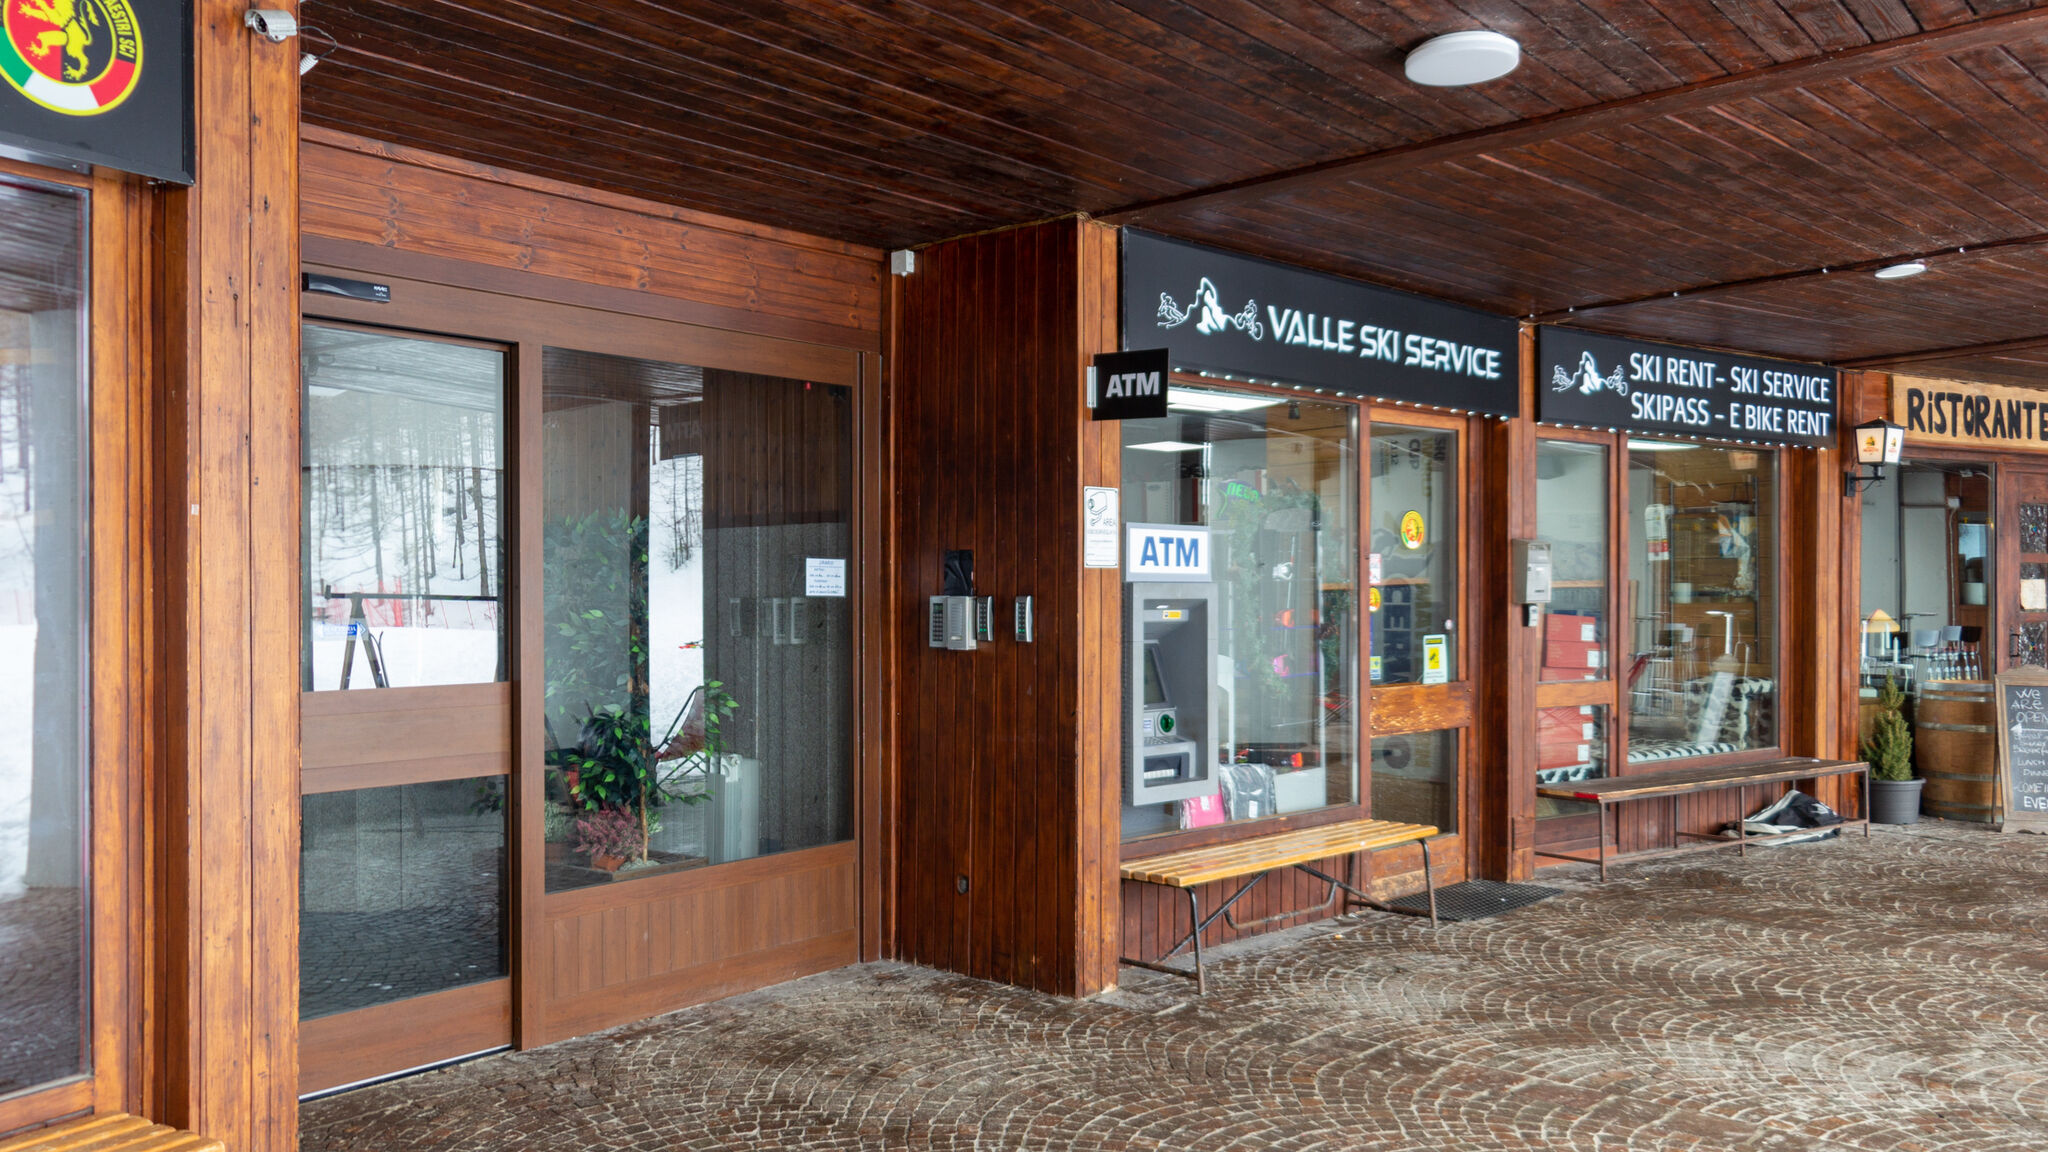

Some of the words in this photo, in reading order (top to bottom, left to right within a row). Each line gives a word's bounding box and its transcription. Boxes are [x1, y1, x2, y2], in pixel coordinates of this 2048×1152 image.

[118, 37, 135, 59] SCI
[1267, 305, 1355, 352] VALLE
[1360, 324, 1400, 363] SKI
[1404, 333, 1502, 379] SERVICE
[1105, 371, 1160, 399] ATM
[1629, 352, 1661, 382] SKI
[1730, 366, 1759, 394] SKI
[1763, 370, 1831, 403] SERVICE
[1630, 391, 1710, 426] SKIPASS
[1729, 402, 1741, 429] E
[1745, 403, 1783, 433] BIKE
[1787, 409, 1831, 437] RENT
[1139, 536, 1199, 567] ATM
[2023, 795, 2048, 810] EVE
